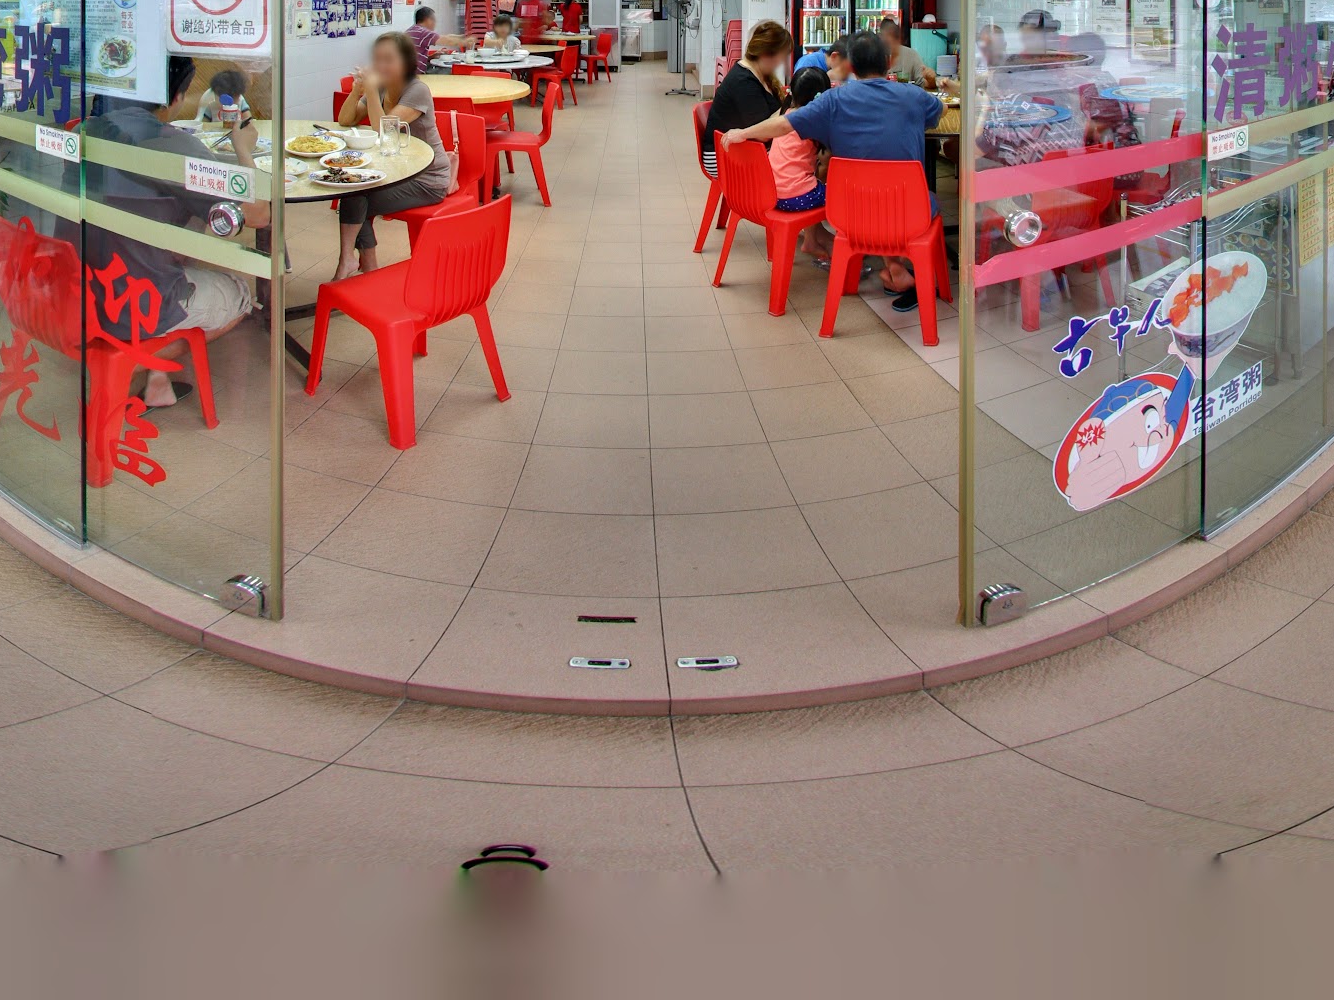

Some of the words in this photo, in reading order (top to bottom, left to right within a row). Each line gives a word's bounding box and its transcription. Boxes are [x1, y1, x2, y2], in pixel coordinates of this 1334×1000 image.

[181, 19, 256, 35] 谢绝外带食品
[39, 126, 45, 135] No
[46, 128, 64, 141] Smoking
[1211, 134, 1218, 143] No
[1218, 130, 1236, 142] Smoking
[39, 137, 63, 152] 禁止吸烟
[1212, 141, 1235, 155] 禁止吸烟
[188, 160, 198, 171] No
[199, 163, 228, 180] Smoking
[189, 174, 226, 193] 禁止吸烟
[1192, 360, 1262, 426] 台湾粥
[1193, 418, 1226, 437] Taiwan
[1228, 390, 1263, 419] Porridge
